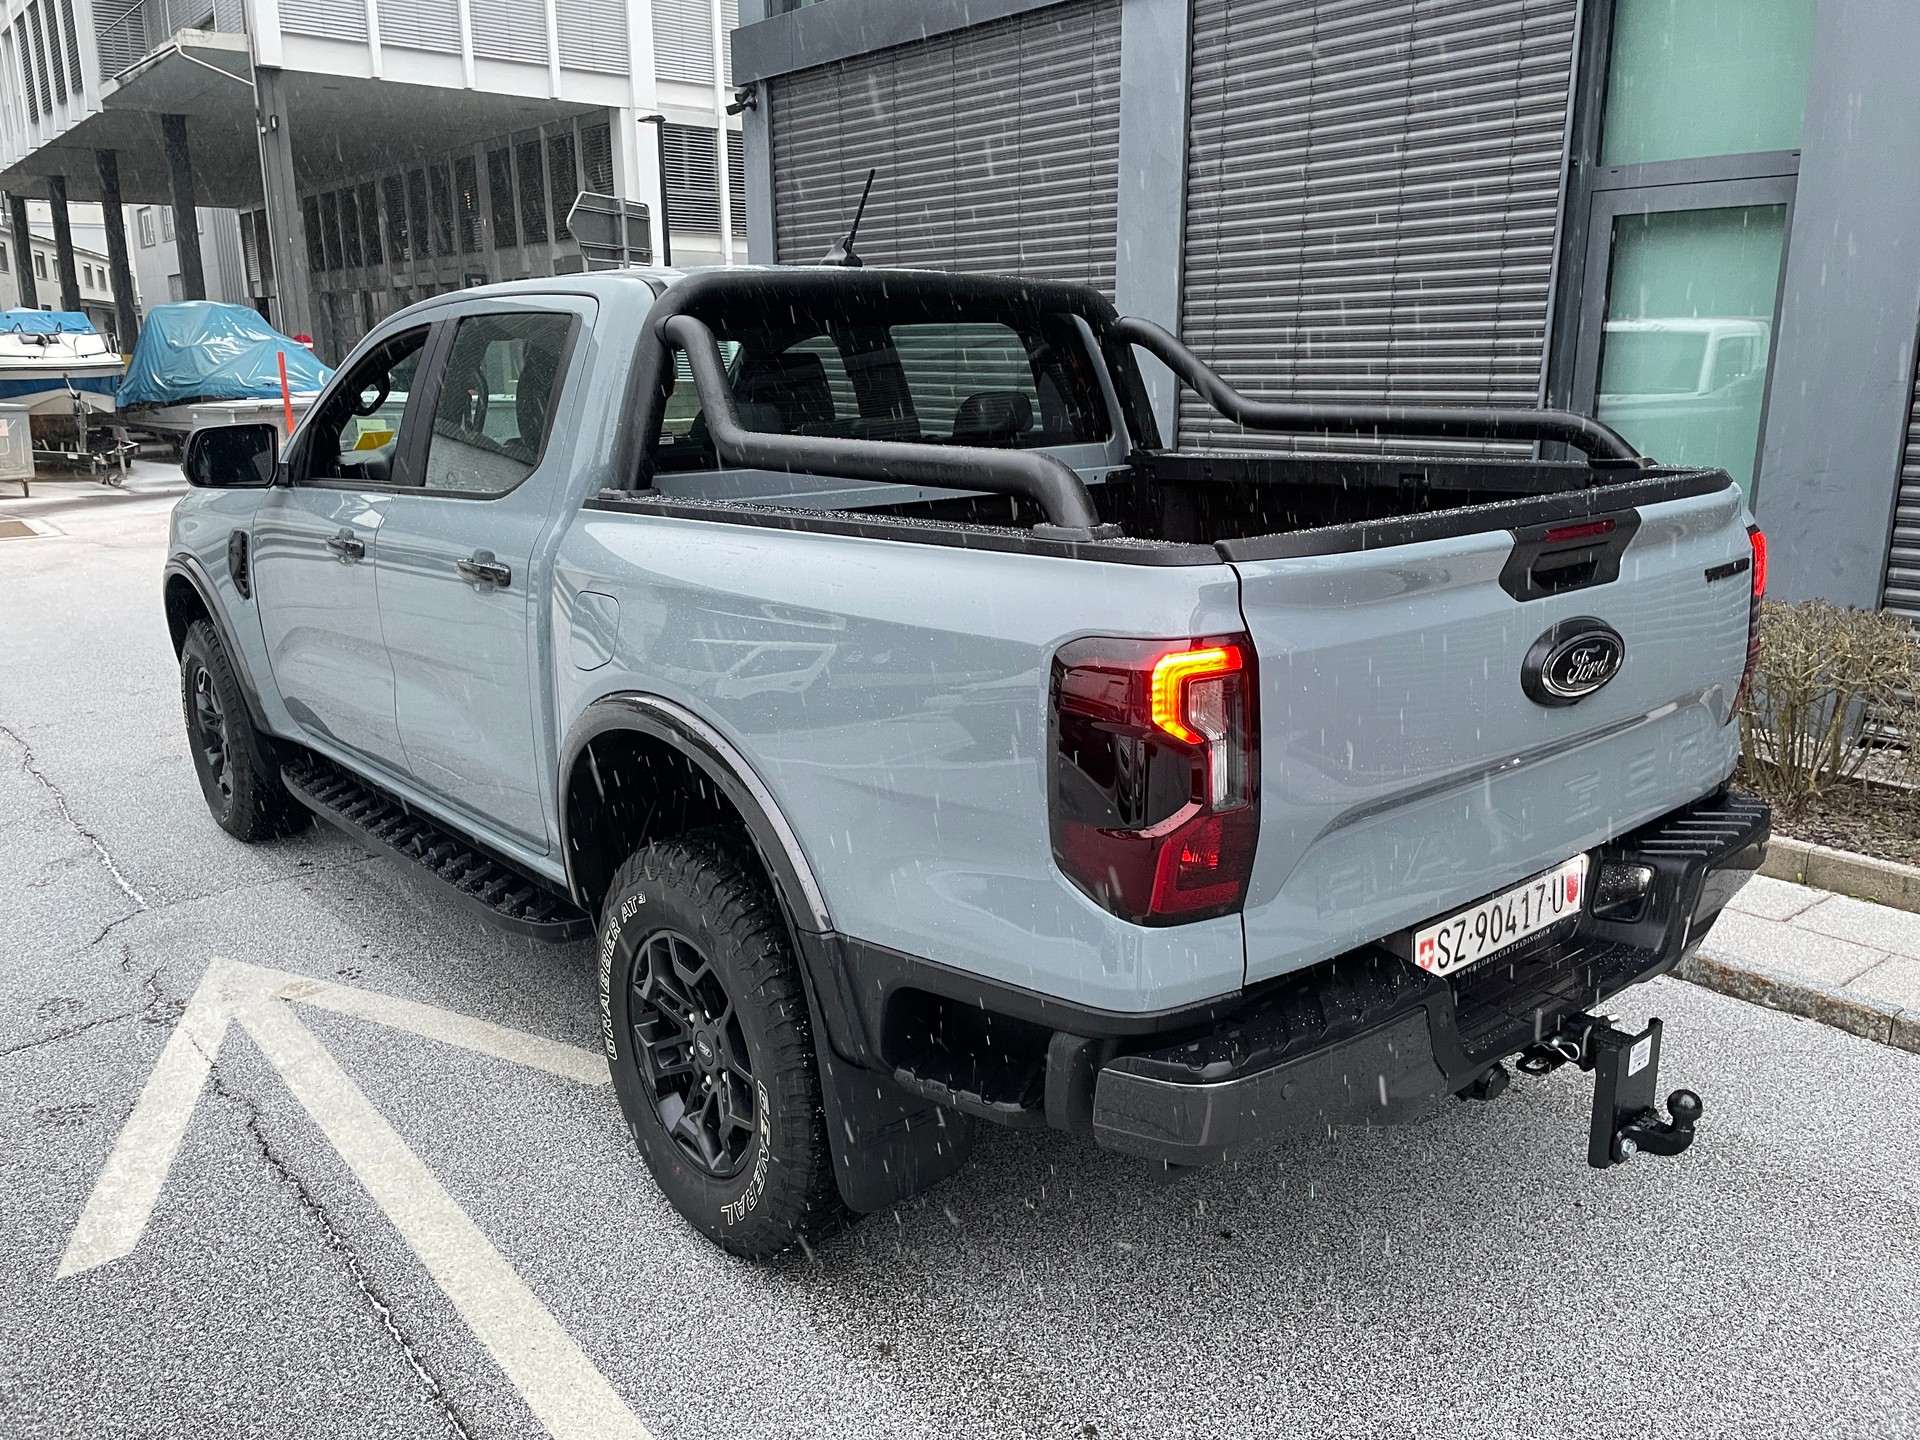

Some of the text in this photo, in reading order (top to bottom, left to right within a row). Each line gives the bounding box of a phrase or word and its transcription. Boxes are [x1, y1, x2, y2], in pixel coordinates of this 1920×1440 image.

[1566, 645, 1609, 684] Ford
[1317, 726, 1734, 920] RANGER
[601, 917, 621, 1061] GRABBER
[720, 1079, 770, 1226] GENERAL
